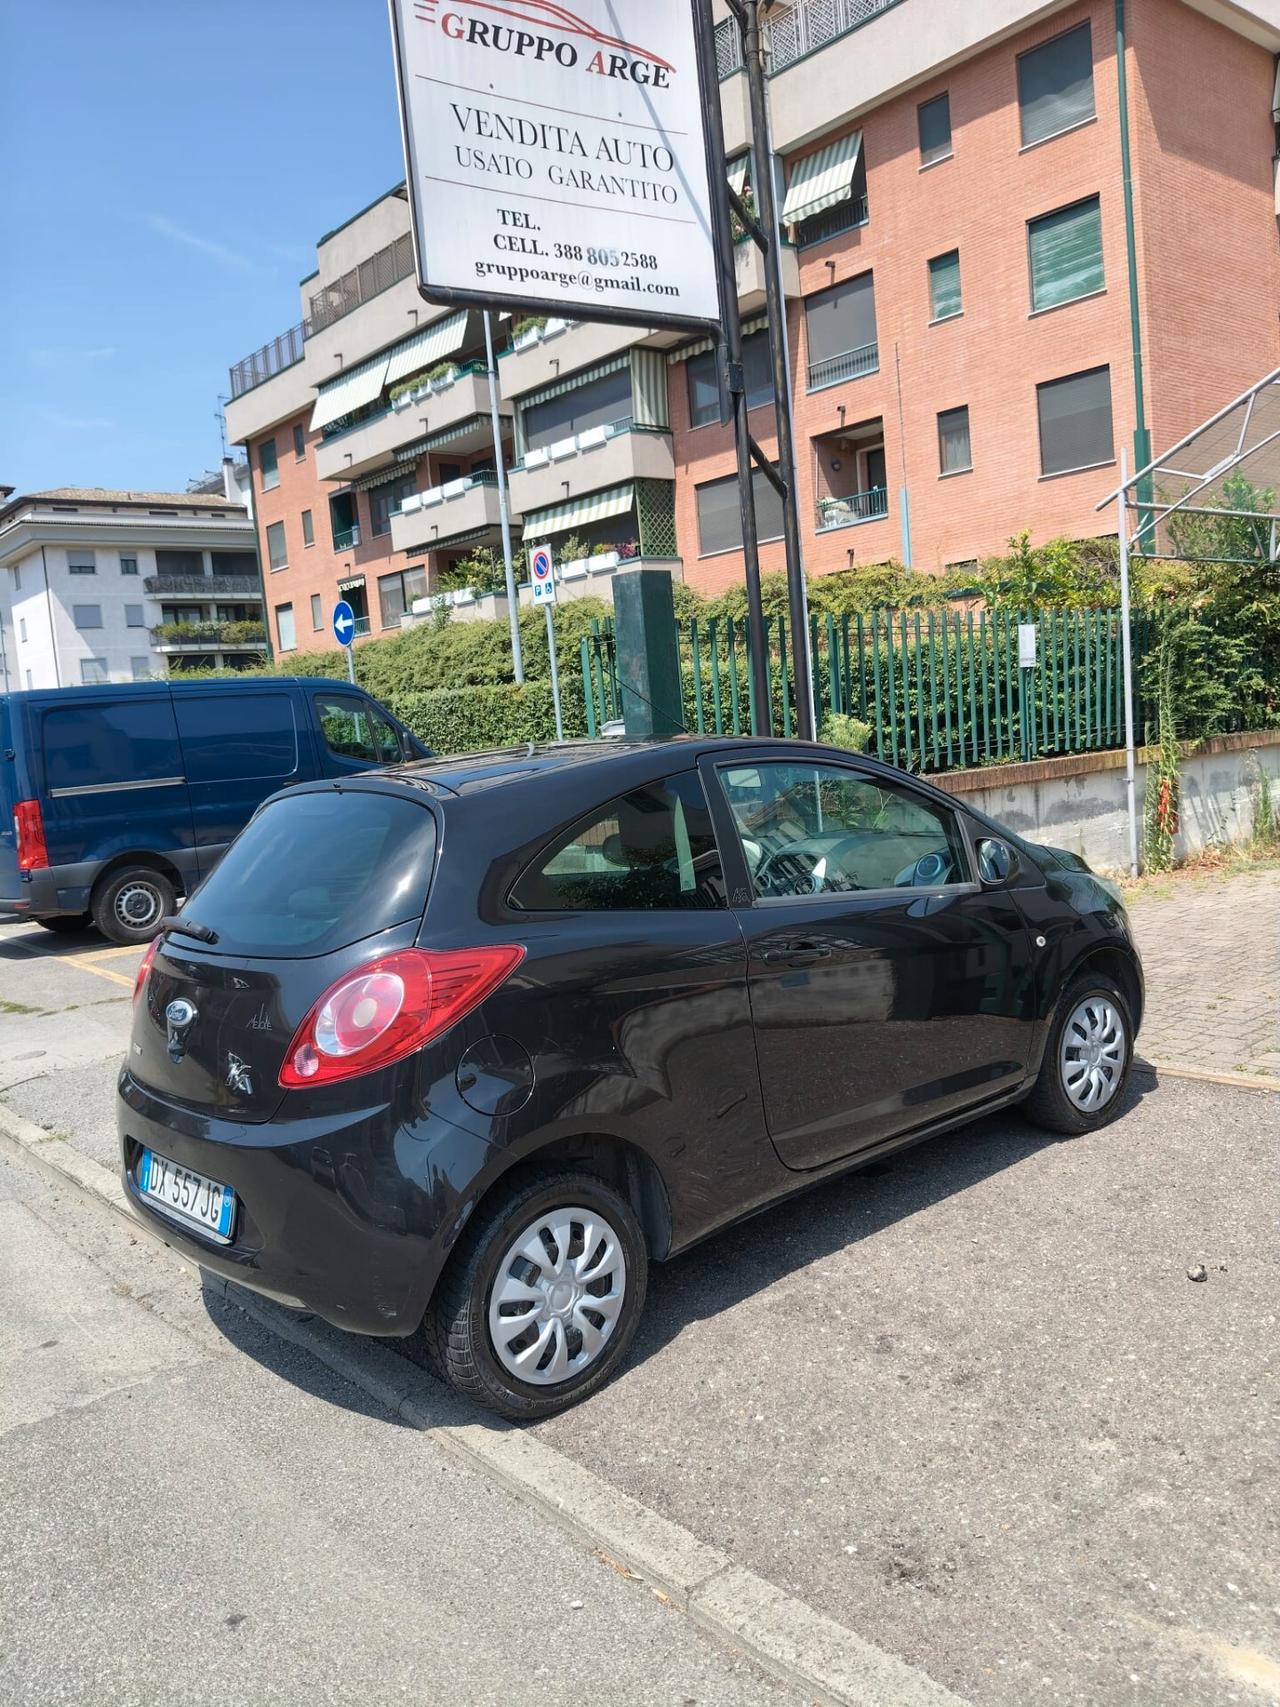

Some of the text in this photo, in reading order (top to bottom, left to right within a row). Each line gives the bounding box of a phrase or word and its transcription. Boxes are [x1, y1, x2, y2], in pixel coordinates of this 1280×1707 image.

[440, 12, 670, 89] GRUPPO ARGE
[449, 102, 674, 173] VENDITA AUTO
[454, 145, 678, 205] USATO GARANTITO
[493, 233, 549, 257] CELL.
[497, 208, 541, 232] TEL.
[475, 260, 680, 297] gruppoarge@gmail.com
[150, 1157, 168, 1196] DX
[172, 1167, 201, 1211] 557
[201, 1181, 220, 1222] JG
